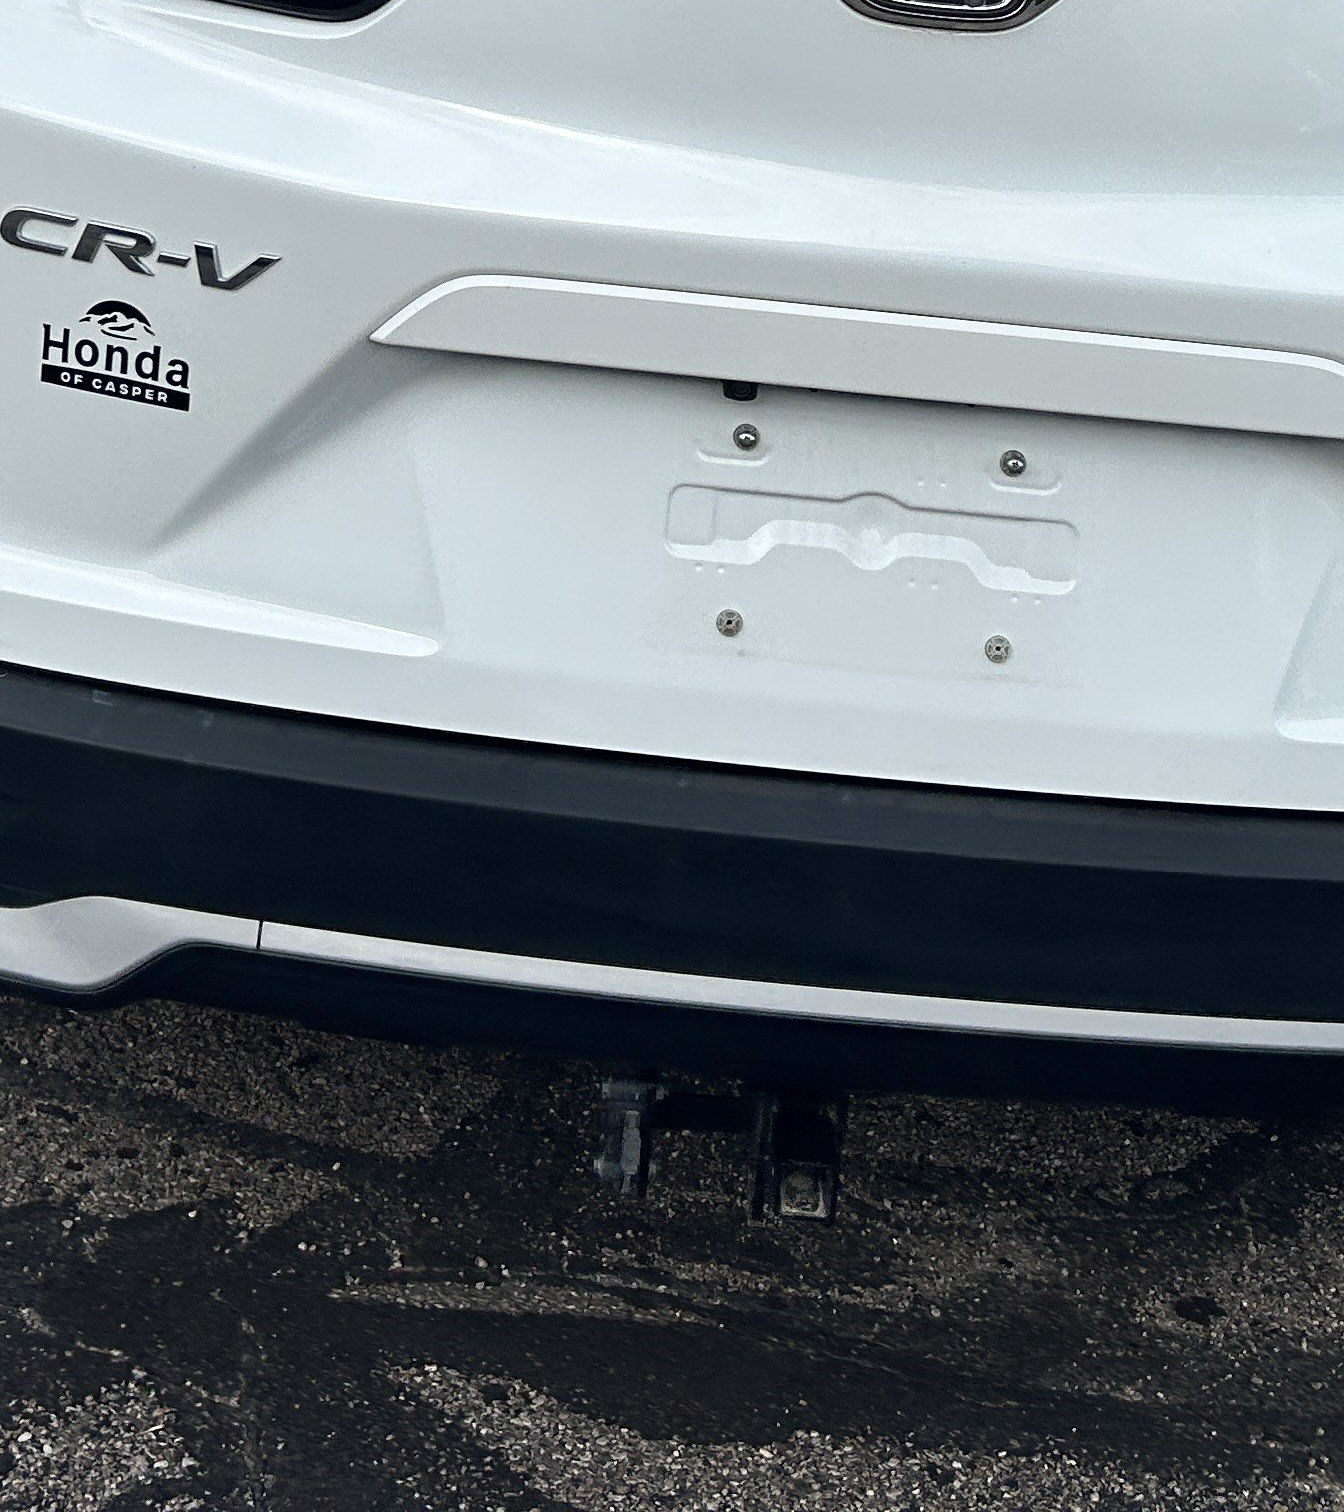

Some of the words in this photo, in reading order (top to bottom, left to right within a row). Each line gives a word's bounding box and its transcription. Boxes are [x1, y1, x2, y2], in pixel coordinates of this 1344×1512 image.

[0, 205, 283, 291] CR-V
[42, 323, 190, 389] Honda
[59, 371, 84, 385] OF
[91, 377, 168, 403] CASPER
